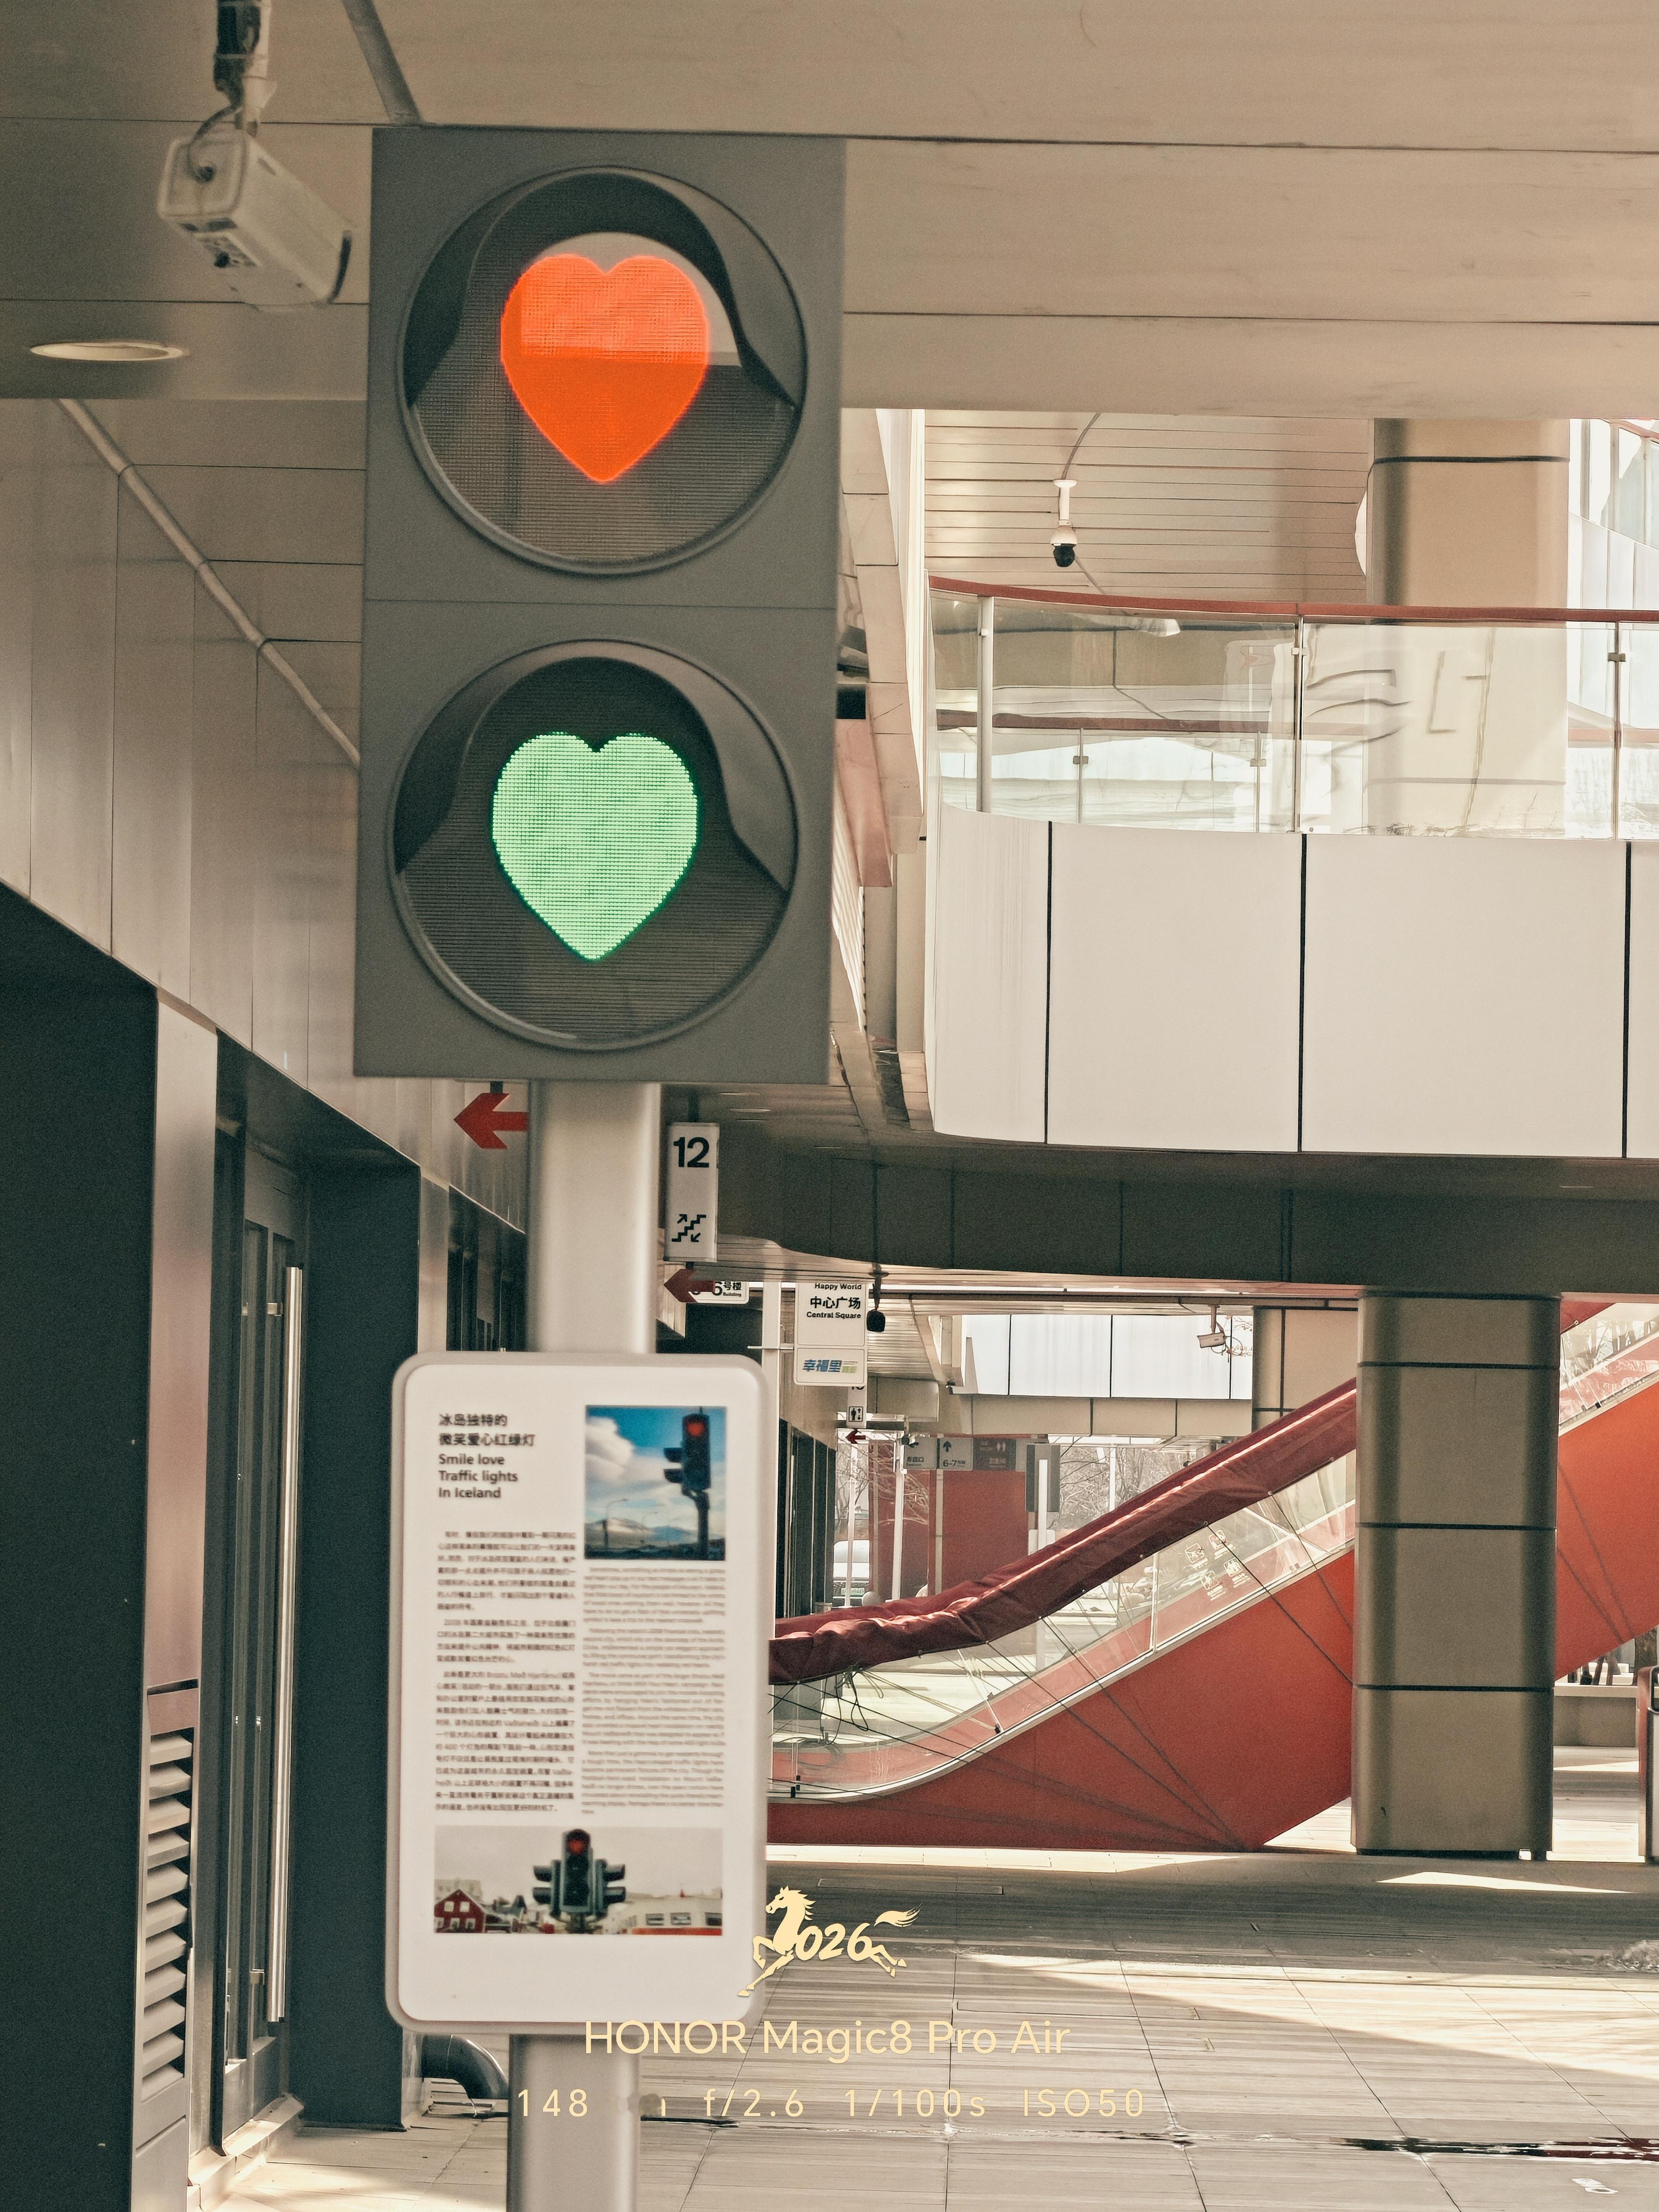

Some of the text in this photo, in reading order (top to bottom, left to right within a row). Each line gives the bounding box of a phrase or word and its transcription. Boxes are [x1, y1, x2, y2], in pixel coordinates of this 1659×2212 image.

[673, 1137, 709, 1167] 12
[810, 1296, 861, 1309] 中心广场
[803, 1359, 842, 1372] 幸福里
[439, 1414, 507, 1426] 冰岛独特的
[439, 1432, 535, 1446] 微笑爱心红绿灯
[439, 1454, 505, 1464] Smile love
[438, 1470, 518, 1484] Traffic lights
[439, 1487, 501, 1498] In Iceland
